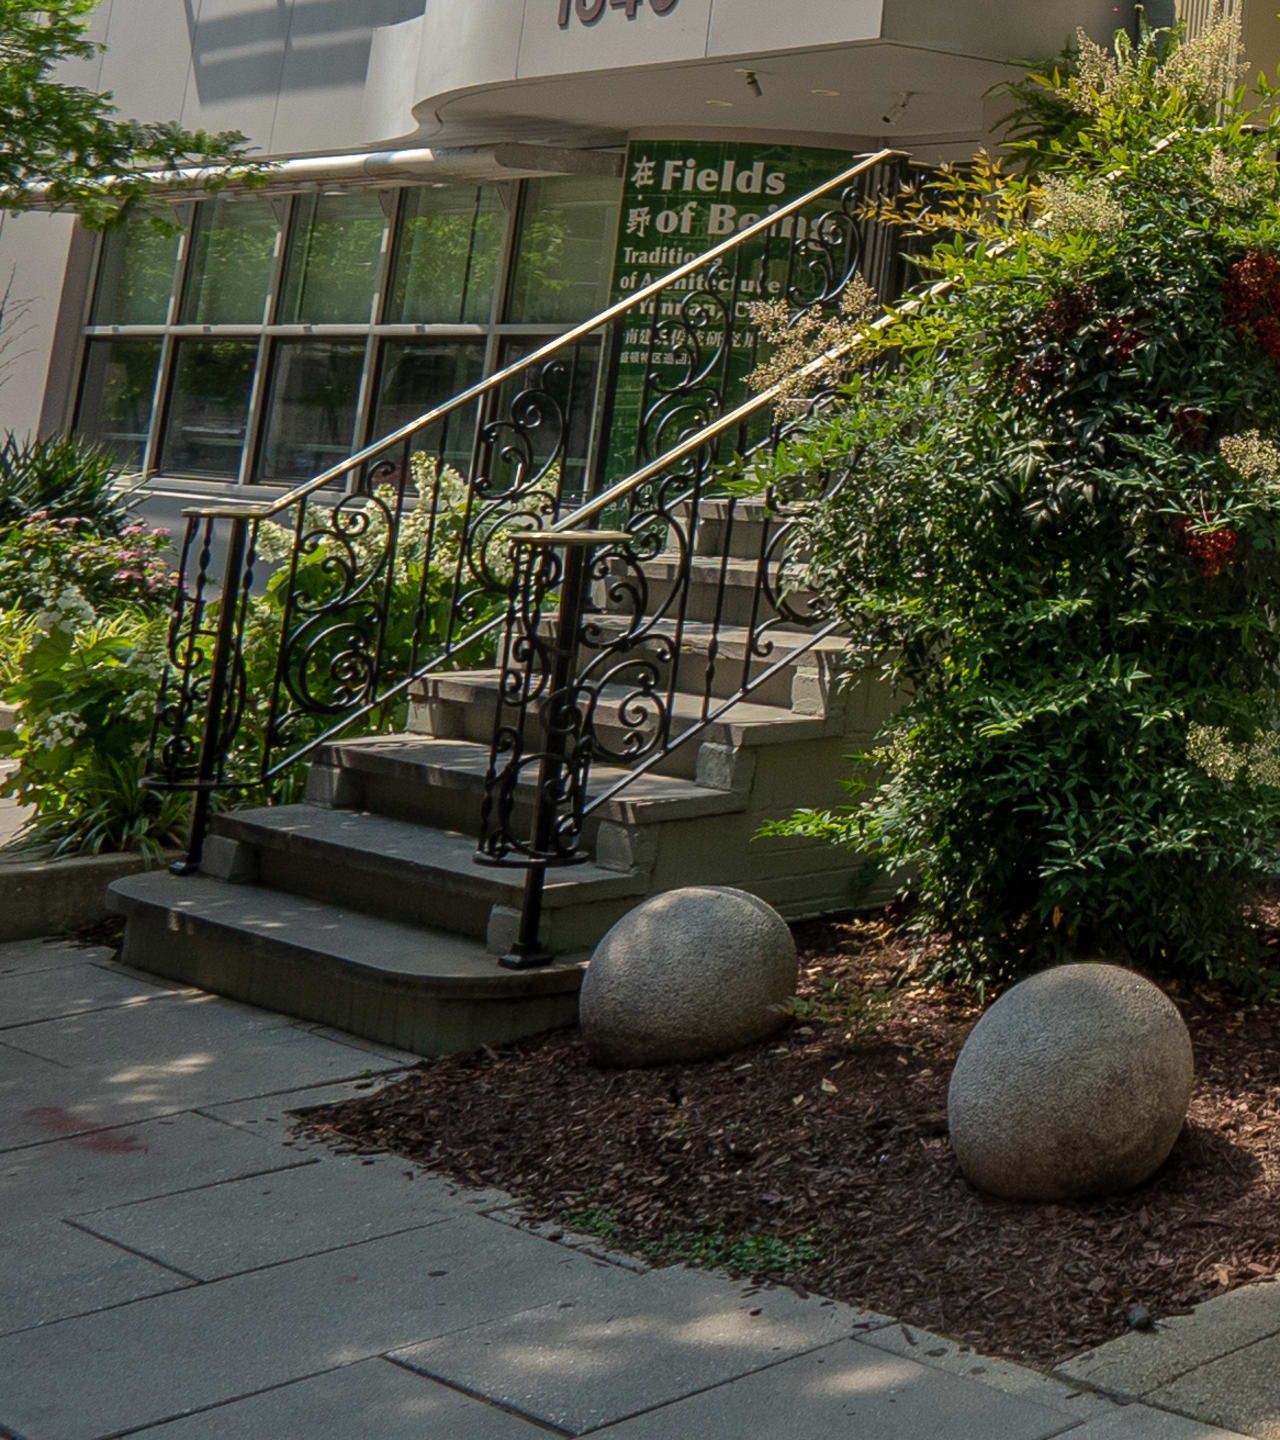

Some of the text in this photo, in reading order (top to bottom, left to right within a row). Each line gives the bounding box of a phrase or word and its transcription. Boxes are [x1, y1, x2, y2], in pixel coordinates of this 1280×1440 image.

[661, 158, 786, 195] Fields
[656, 201, 698, 234] of
[620, 271, 638, 289] of
